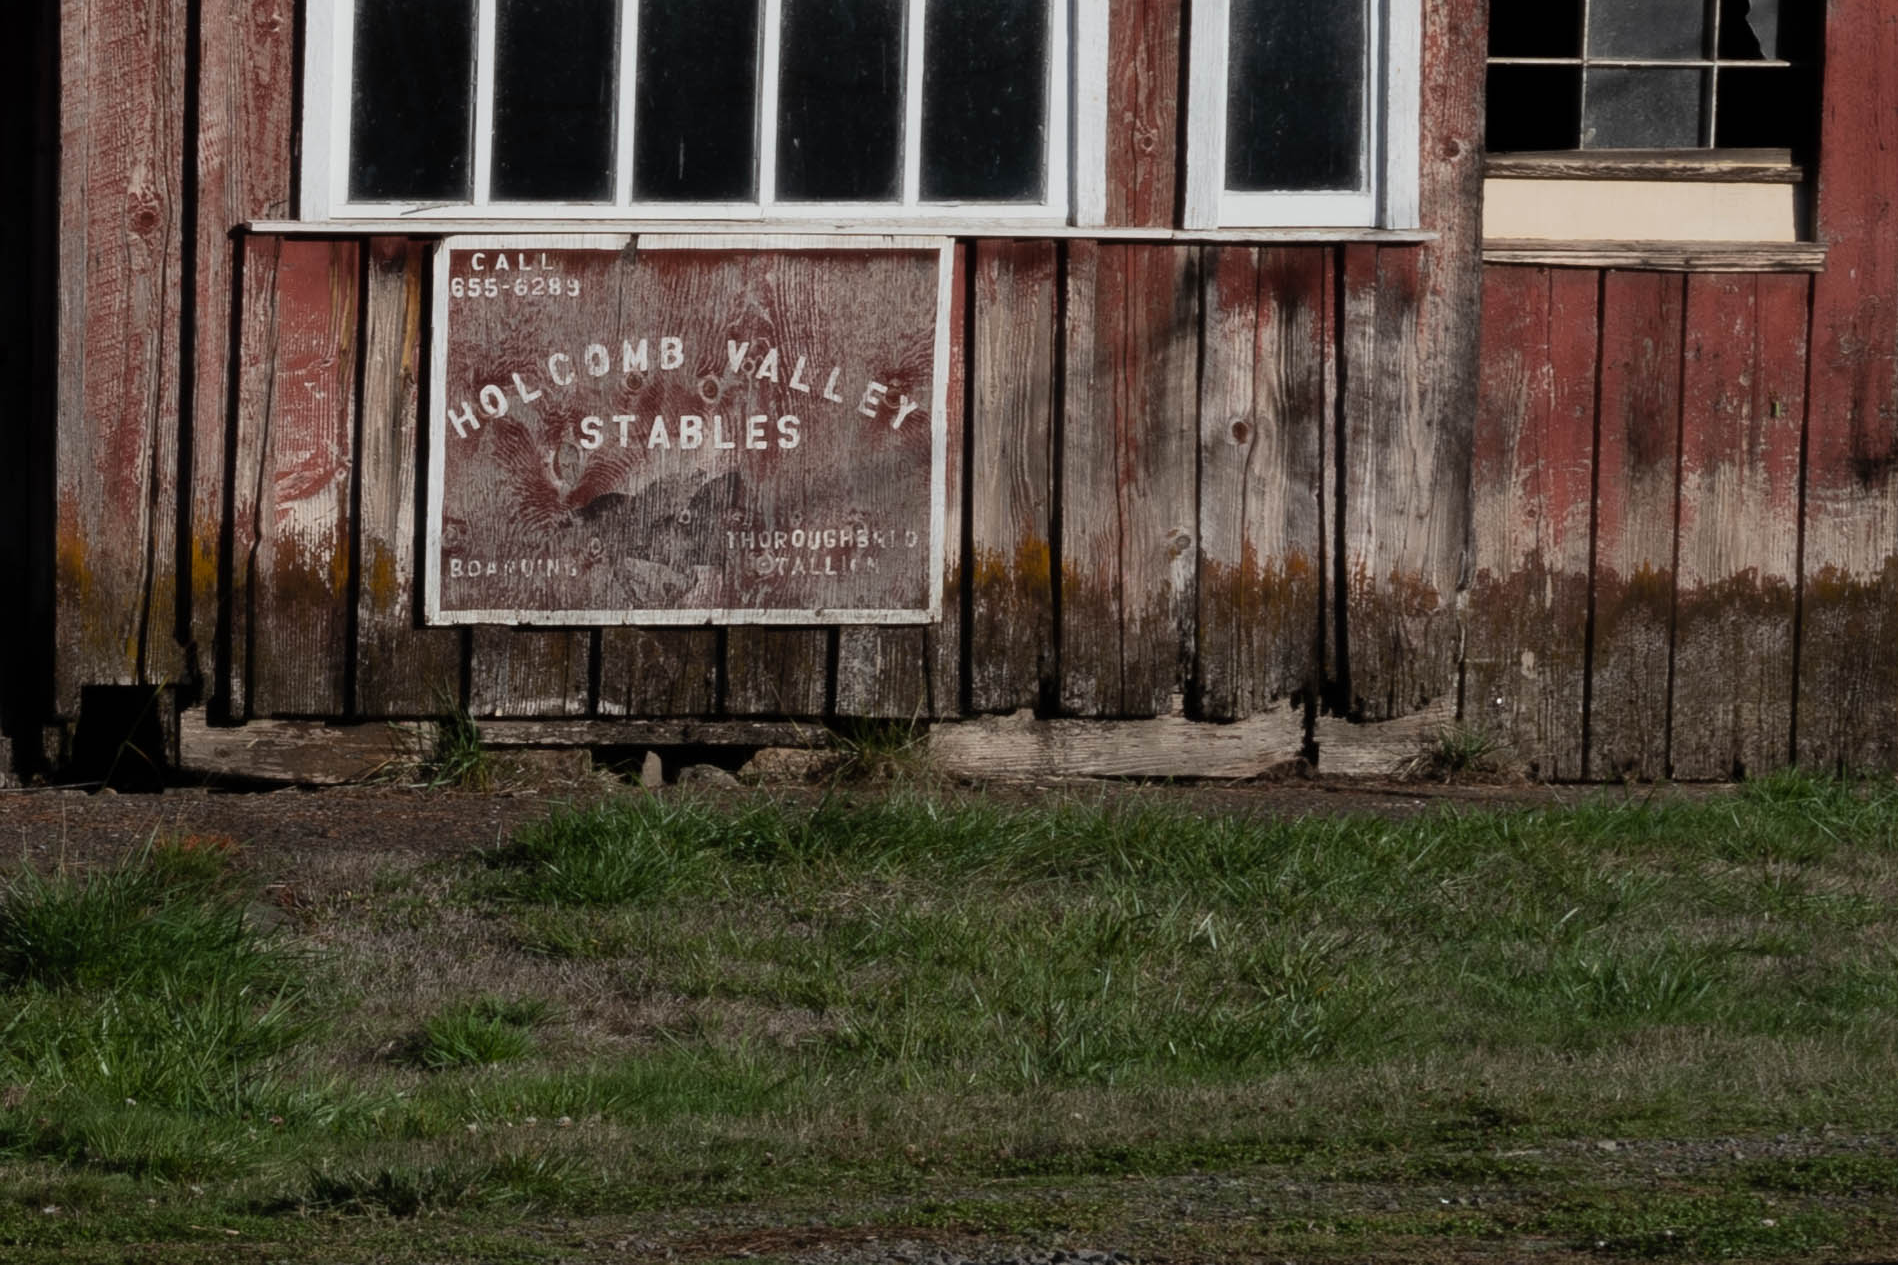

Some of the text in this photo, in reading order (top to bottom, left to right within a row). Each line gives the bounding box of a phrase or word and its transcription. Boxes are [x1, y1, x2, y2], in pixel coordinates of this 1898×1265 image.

[471, 252, 554, 271] CALL
[450, 276, 581, 298] 655-6289
[447, 335, 920, 439] HOLCOMB VALLEY
[579, 414, 802, 451] STABLES
[449, 558, 578, 578] BOARDNG
[756, 554, 881, 577] TALLIN
